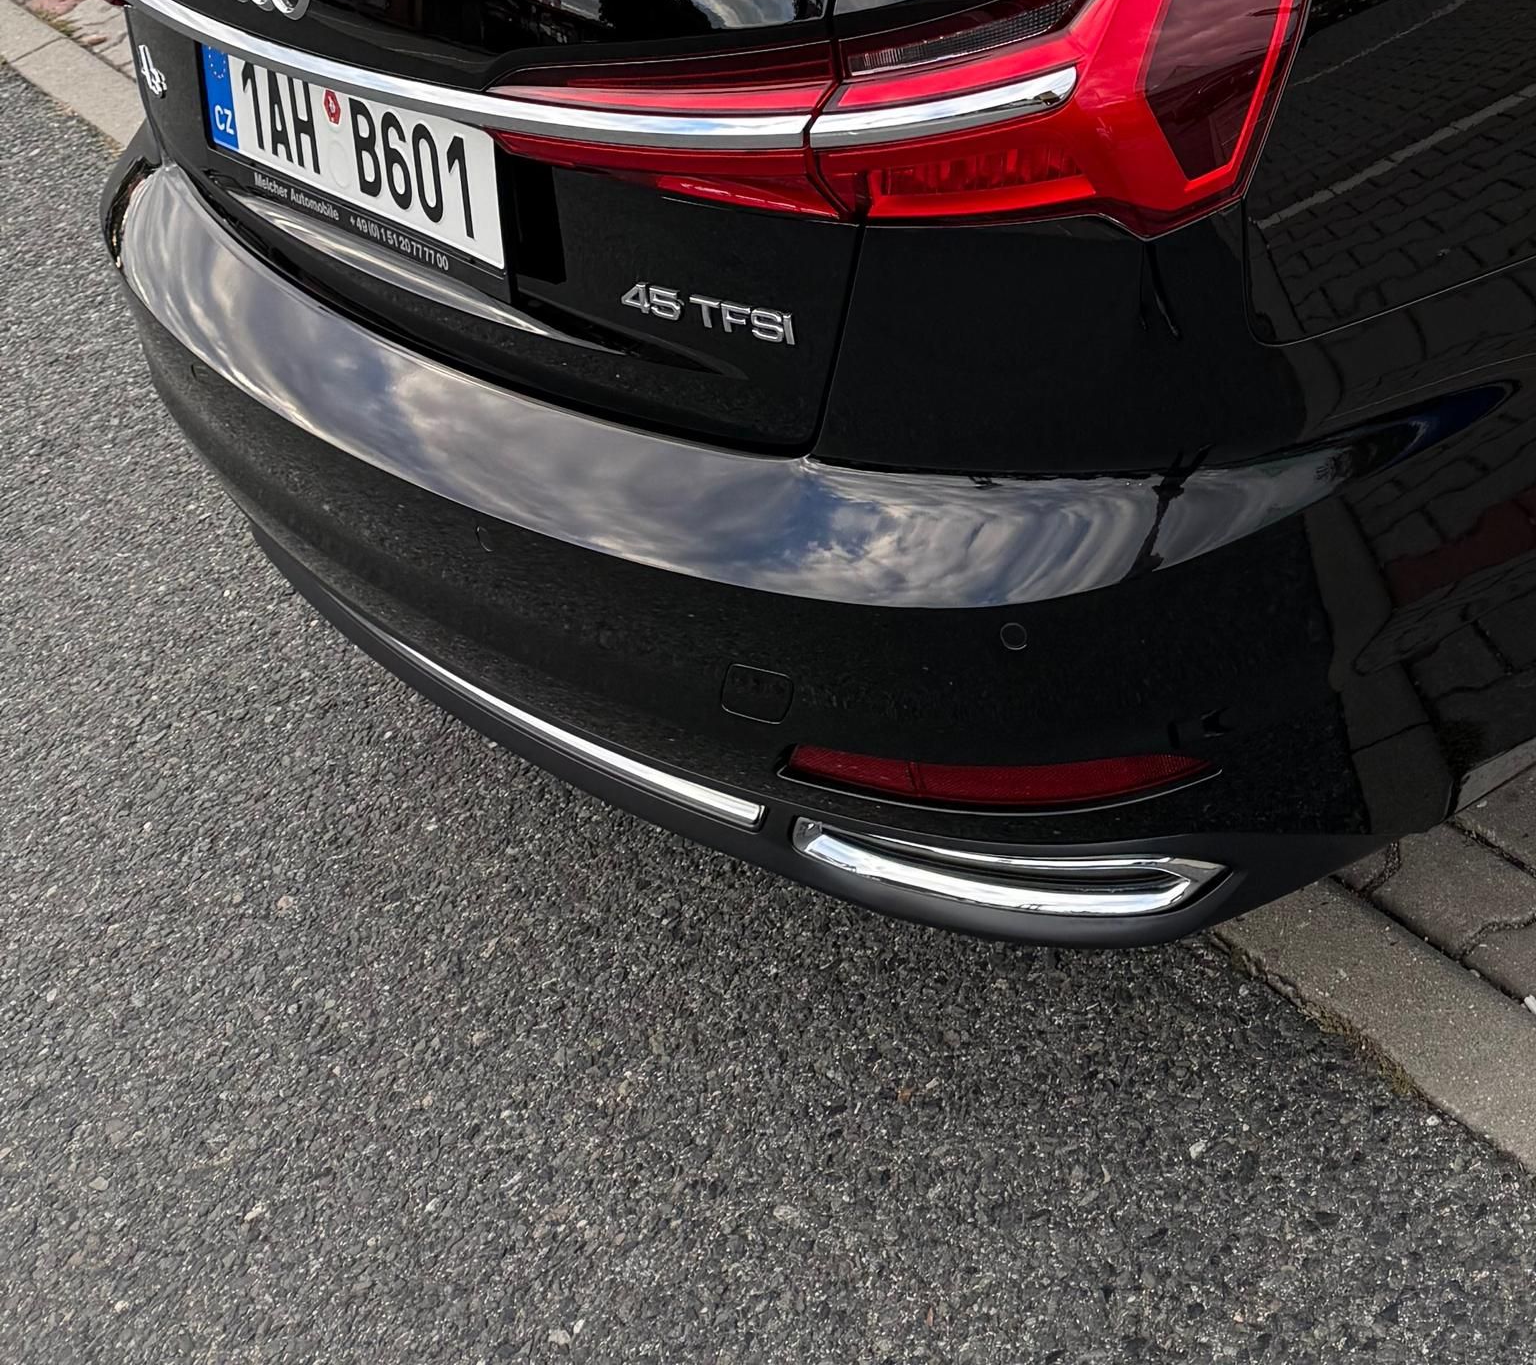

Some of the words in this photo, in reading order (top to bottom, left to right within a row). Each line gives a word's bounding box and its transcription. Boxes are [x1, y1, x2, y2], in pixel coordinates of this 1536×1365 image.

[214, 104, 235, 136] CZ
[242, 60, 321, 175] 1AH
[348, 97, 475, 241] B601
[254, 171, 288, 200] Melcher
[290, 187, 340, 222] Automobile
[621, 281, 685, 321] 45
[689, 294, 796, 346] TFSI
